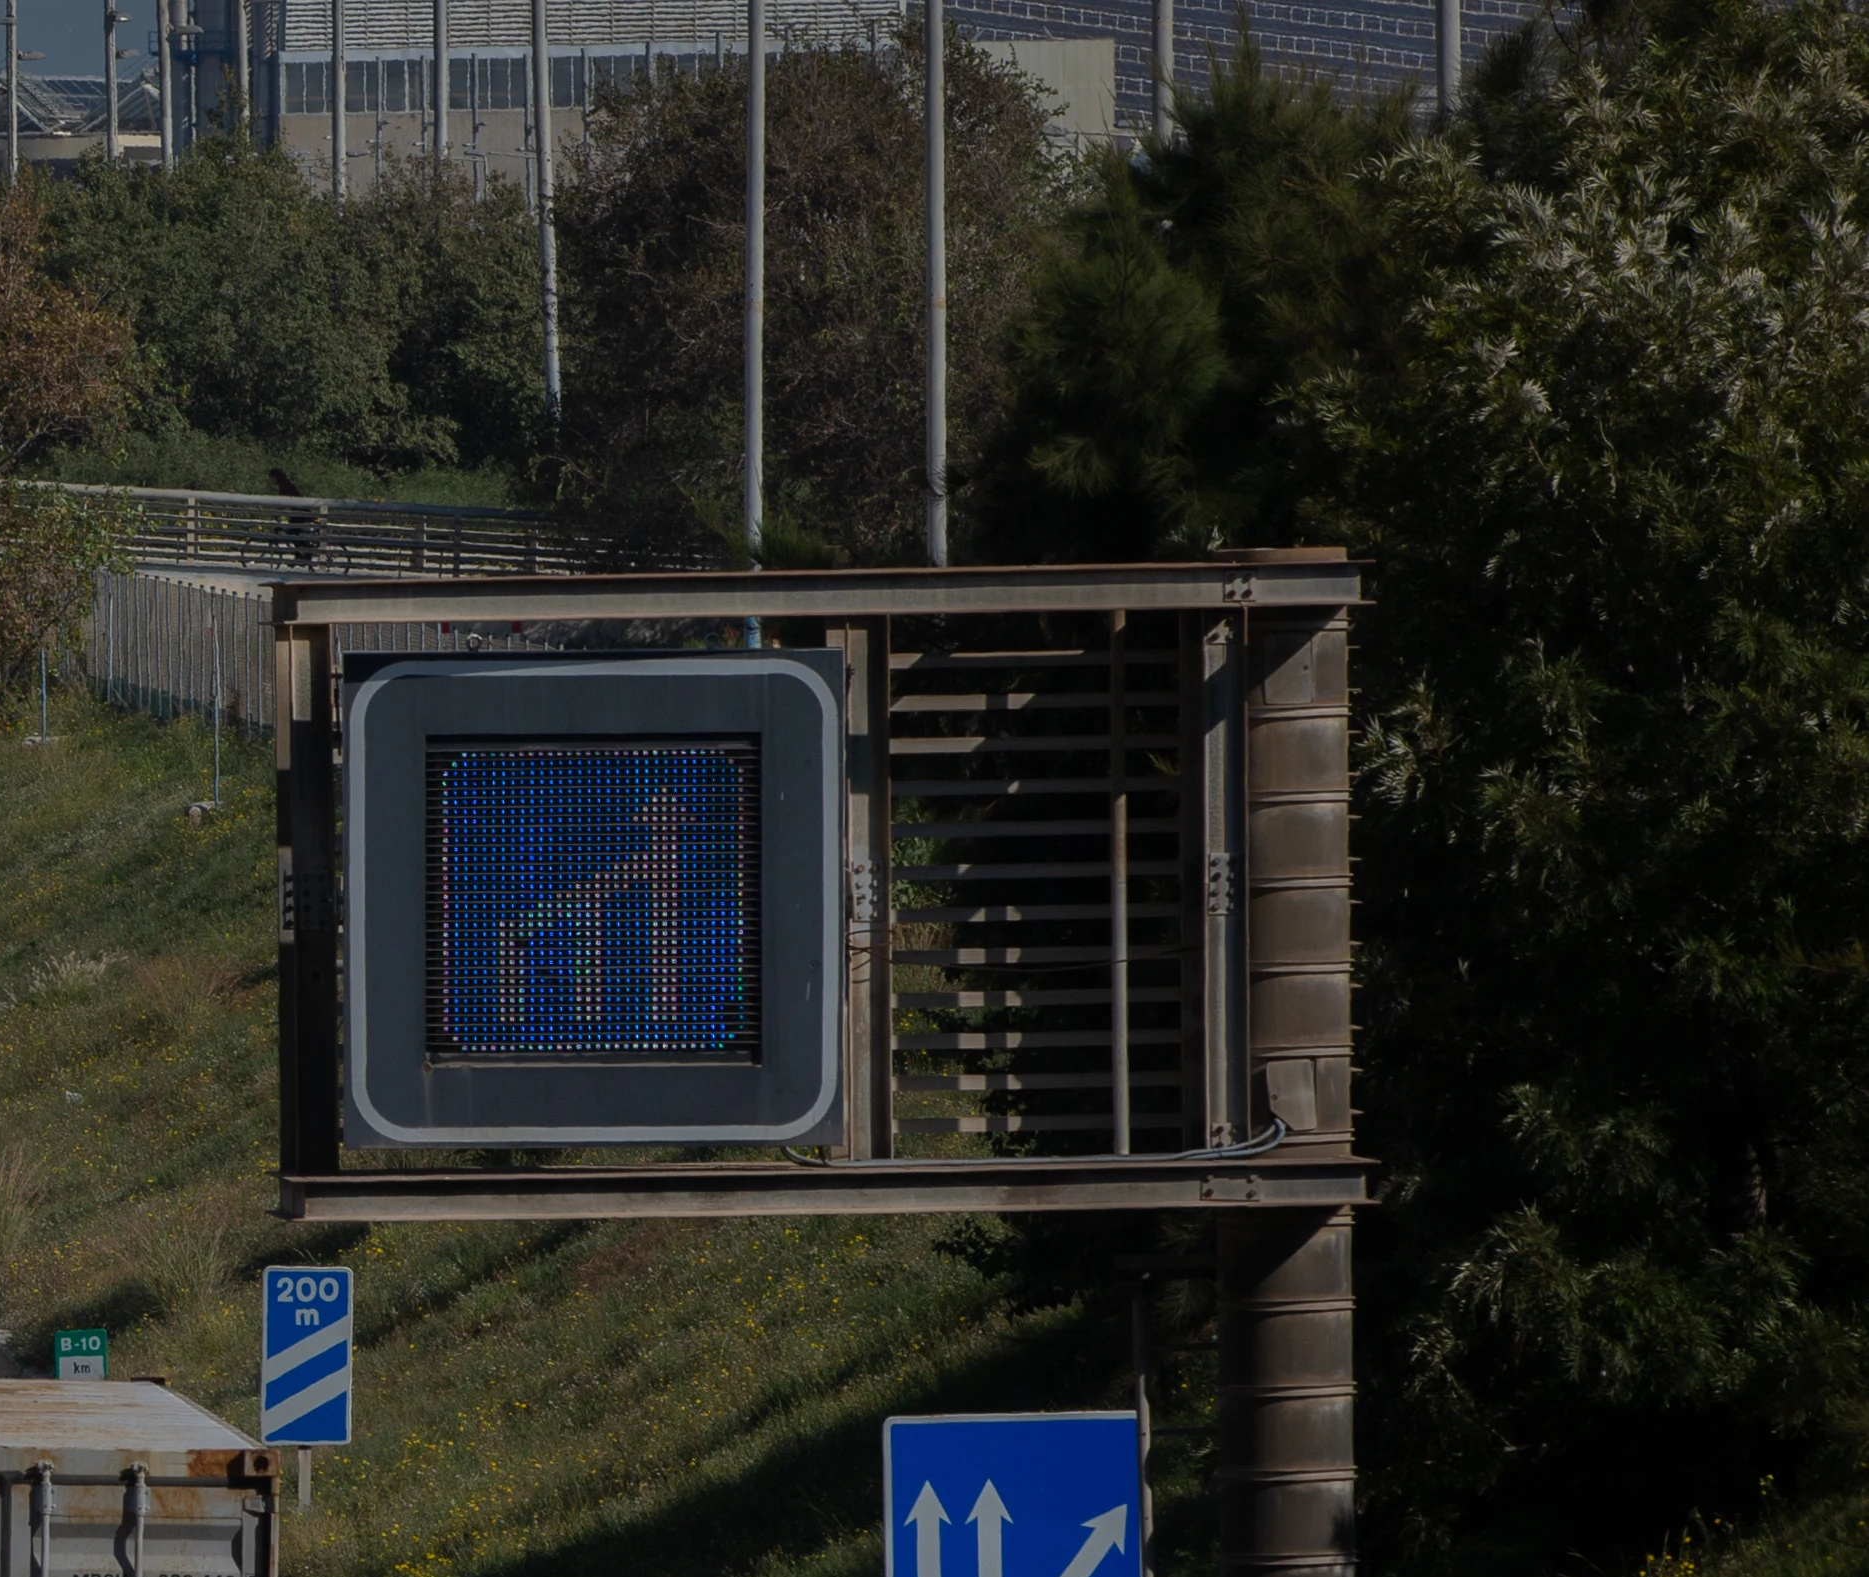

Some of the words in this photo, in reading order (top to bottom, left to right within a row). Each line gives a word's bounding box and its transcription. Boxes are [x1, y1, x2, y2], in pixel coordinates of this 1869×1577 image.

[276, 1276, 340, 1304] 200
[294, 1306, 321, 1327] m
[60, 1336, 102, 1352] B-10
[73, 1362, 91, 1375] km
